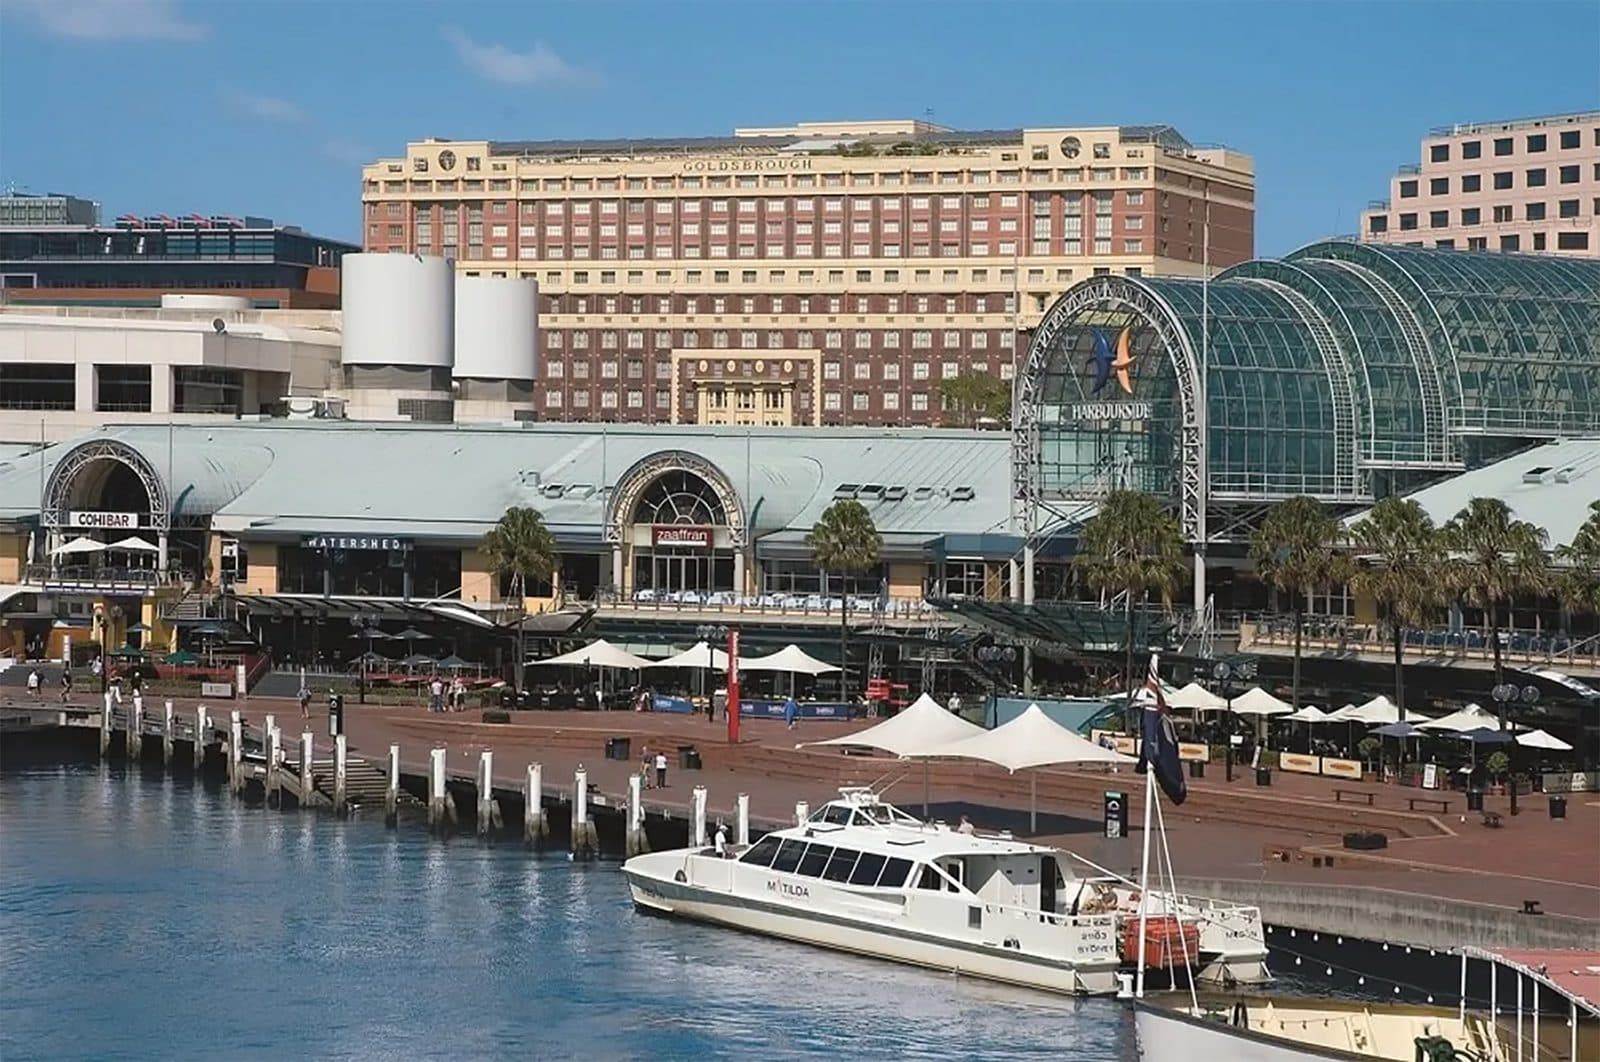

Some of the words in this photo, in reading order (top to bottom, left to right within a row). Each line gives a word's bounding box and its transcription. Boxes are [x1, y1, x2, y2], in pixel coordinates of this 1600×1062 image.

[683, 159, 812, 171] GOLDSBROUGH
[1072, 403, 1152, 420] HARBOURSIDE
[657, 529, 708, 541] zaaffran
[308, 538, 400, 550] WATERSHED
